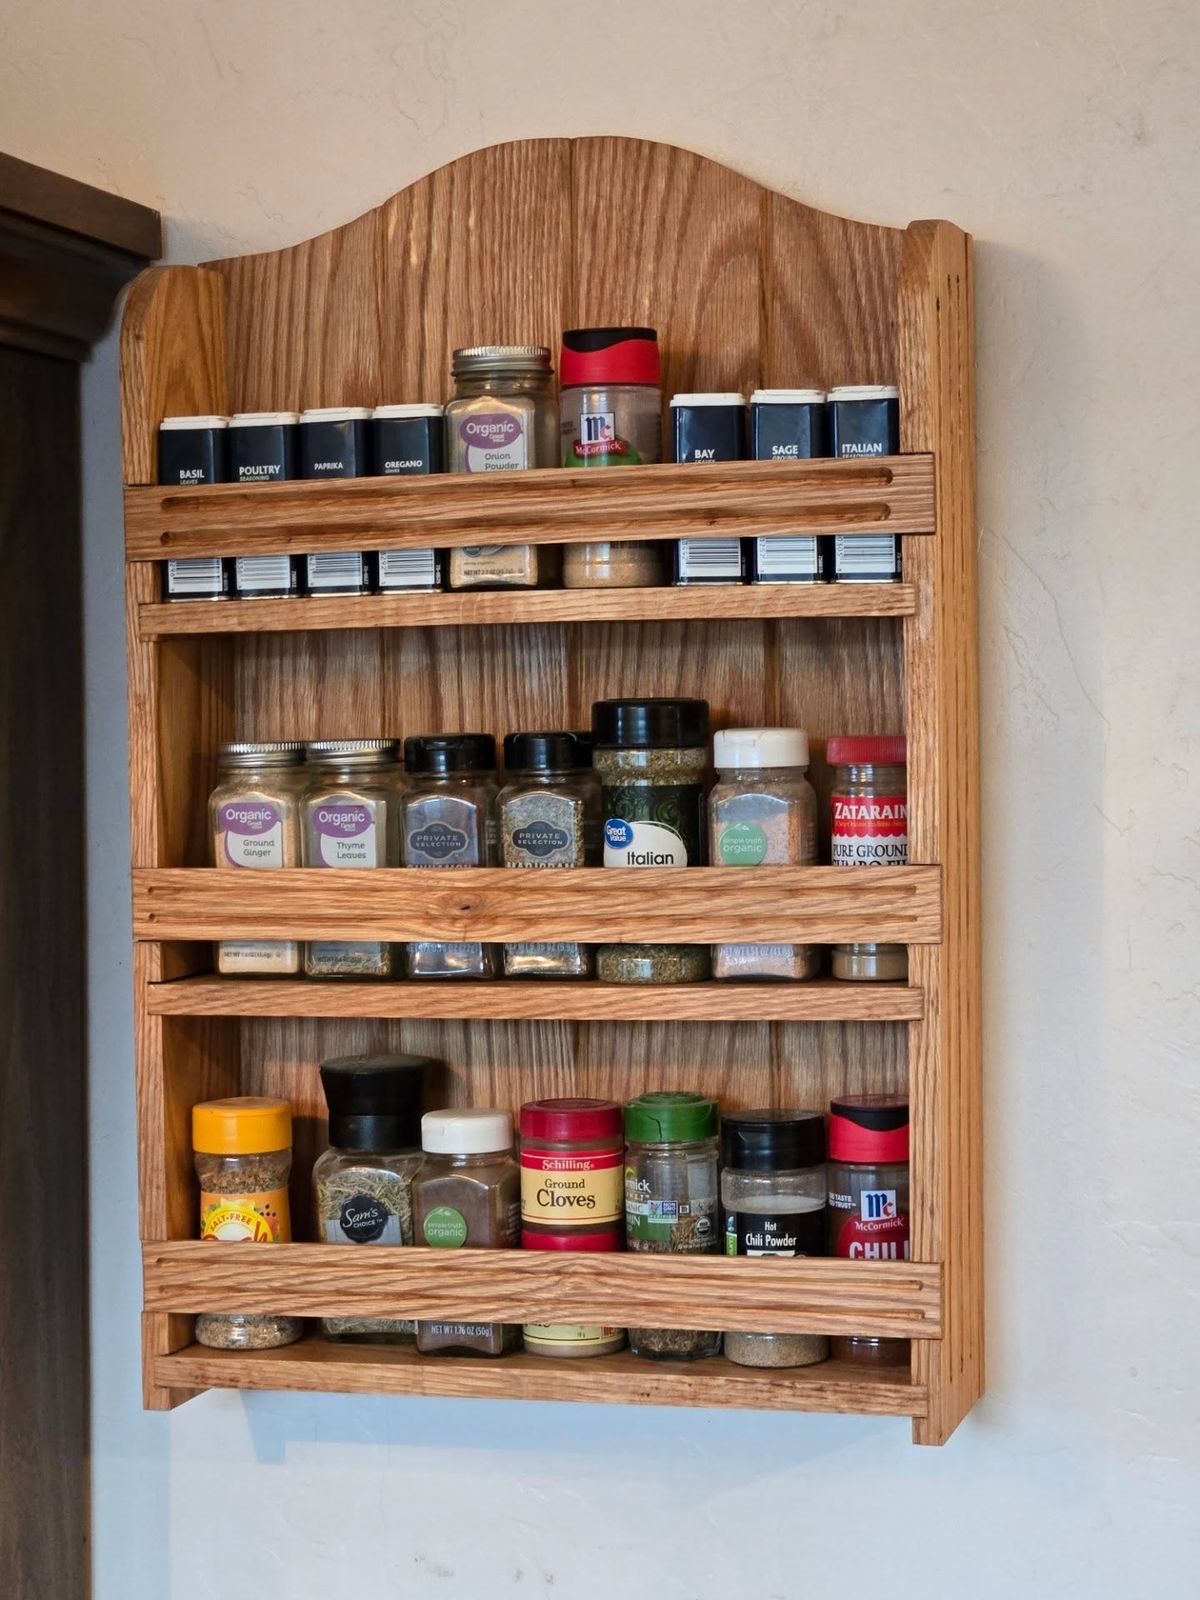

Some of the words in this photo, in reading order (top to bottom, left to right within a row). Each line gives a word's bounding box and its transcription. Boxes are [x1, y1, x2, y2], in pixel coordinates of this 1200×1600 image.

[466, 420, 515, 437] Organic
[575, 441, 622, 455] McCormick
[772, 445, 799, 455] SAGE
[842, 443, 882, 453] ITALIAN
[694, 449, 715, 459] BAY
[314, 462, 343, 470] PAPRIKA
[385, 460, 422, 469] OREGANO
[485, 462, 519, 470] Powder
[179, 469, 204, 479] BASIL
[239, 465, 280, 475] POULTRY
[226, 808, 272, 823] Organic
[318, 810, 365, 826] Organic
[606, 825, 626, 836] Great
[337, 842, 365, 850] Thyme
[723, 844, 762, 853] organic
[243, 849, 271, 857] Ginger
[627, 851, 674, 865] Italian
[542, 1160, 591, 1170] Schilling
[544, 1179, 586, 1188] Ground
[537, 1188, 596, 1209] Cloves
[835, 1194, 852, 1202] TASTE
[210, 1212, 252, 1231] SALT-FREE
[342, 1207, 379, 1228] Sam's
[765, 1221, 777, 1231] Hot
[854, 1217, 905, 1231] McCormick
[428, 1228, 464, 1237] organic
[745, 1233, 763, 1246] Chili
[765, 1233, 797, 1246] Powder
[431, 1325, 442, 1334] NET
[444, 1325, 453, 1334] WT
[467, 1327, 474, 1335] OZ
